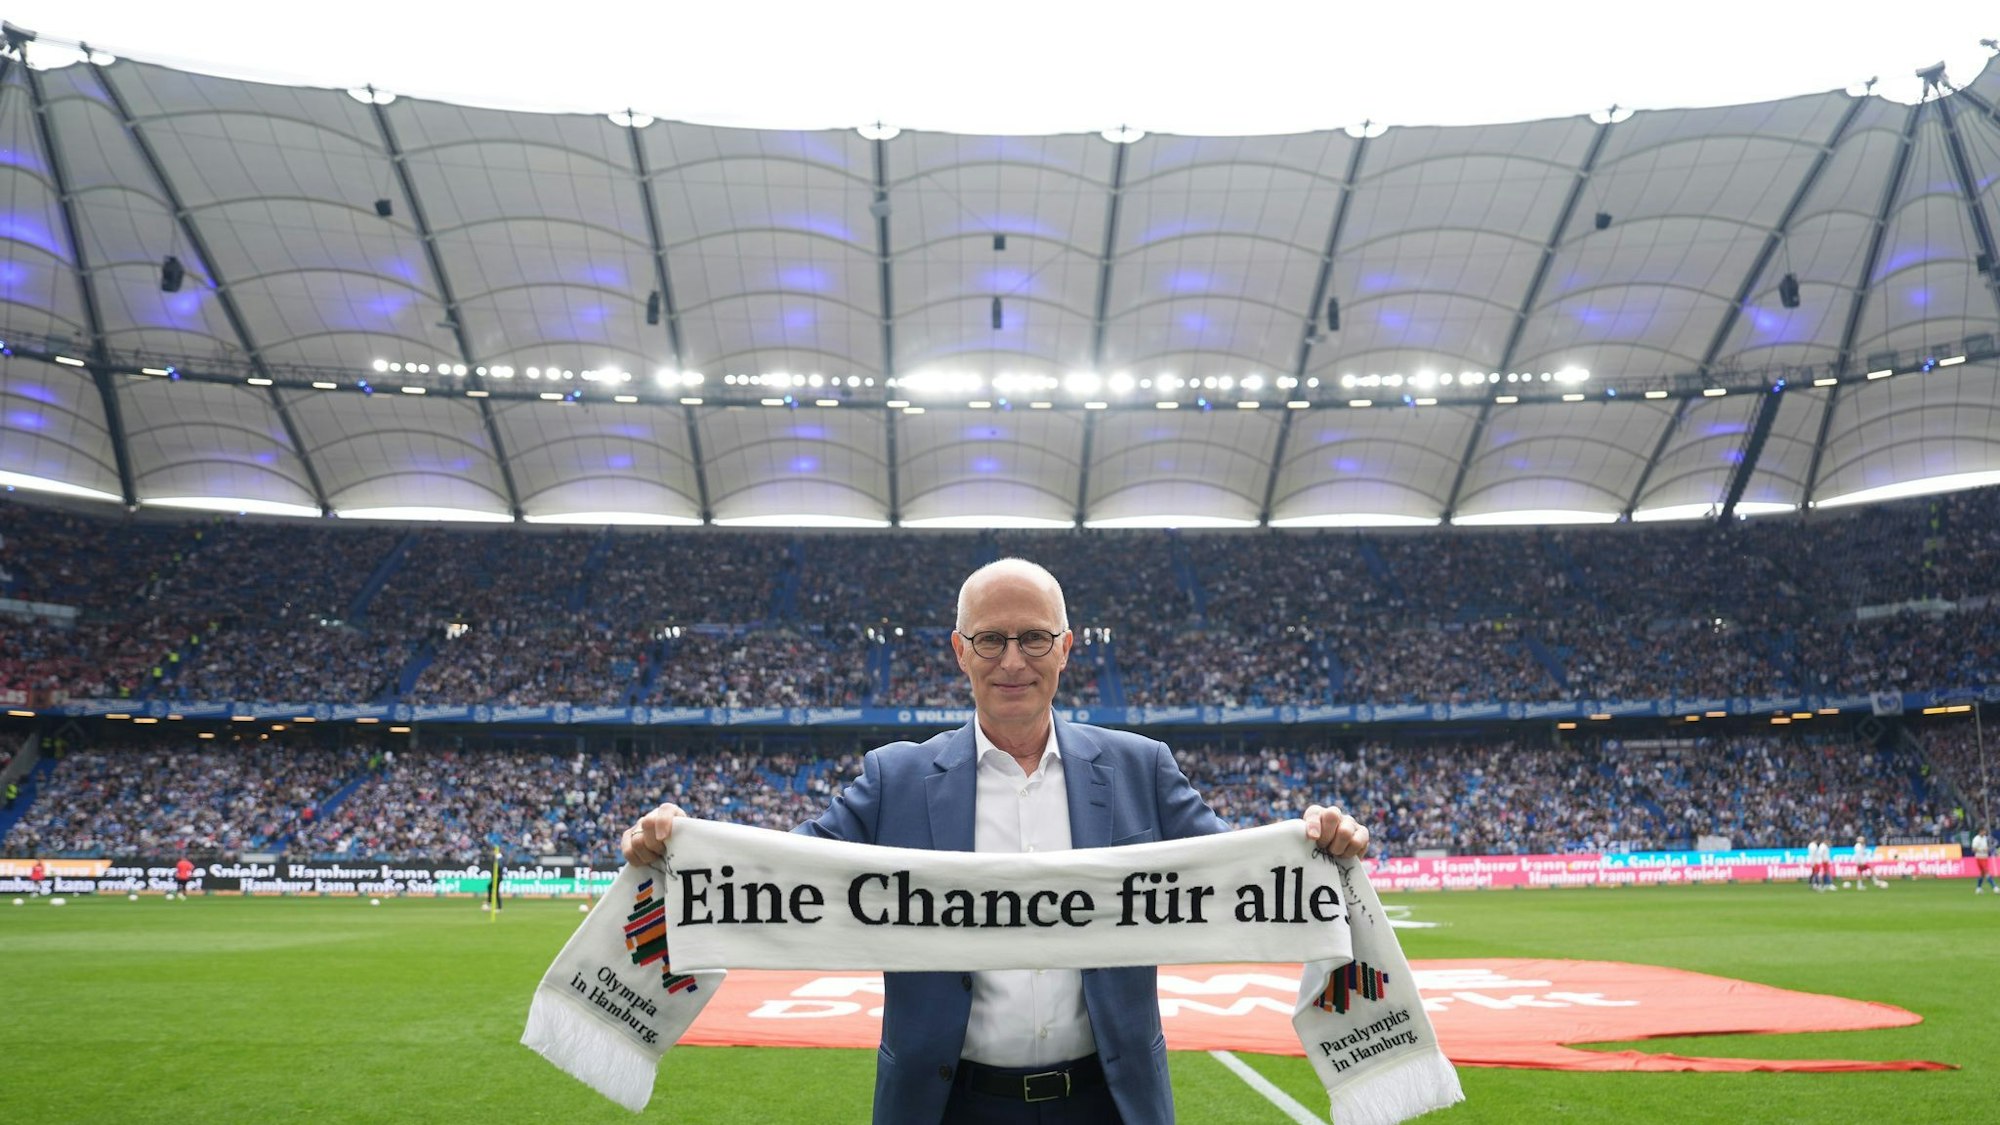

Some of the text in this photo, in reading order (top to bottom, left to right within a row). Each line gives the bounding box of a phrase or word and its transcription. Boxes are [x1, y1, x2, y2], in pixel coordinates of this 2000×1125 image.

[381, 864, 430, 879] kann
[1521, 857, 1567, 872] kann
[1701, 852, 1782, 867] Hamburg
[677, 865, 824, 927] Eine
[848, 870, 1095, 927] Chance
[1115, 871, 1215, 927] für
[570, 972, 660, 1044] in Hamburg.
[597, 966, 657, 1017] Olympia
[1320, 1009, 1410, 1056] Paralympics
[1332, 1029, 1419, 1073] in Hamburg.
